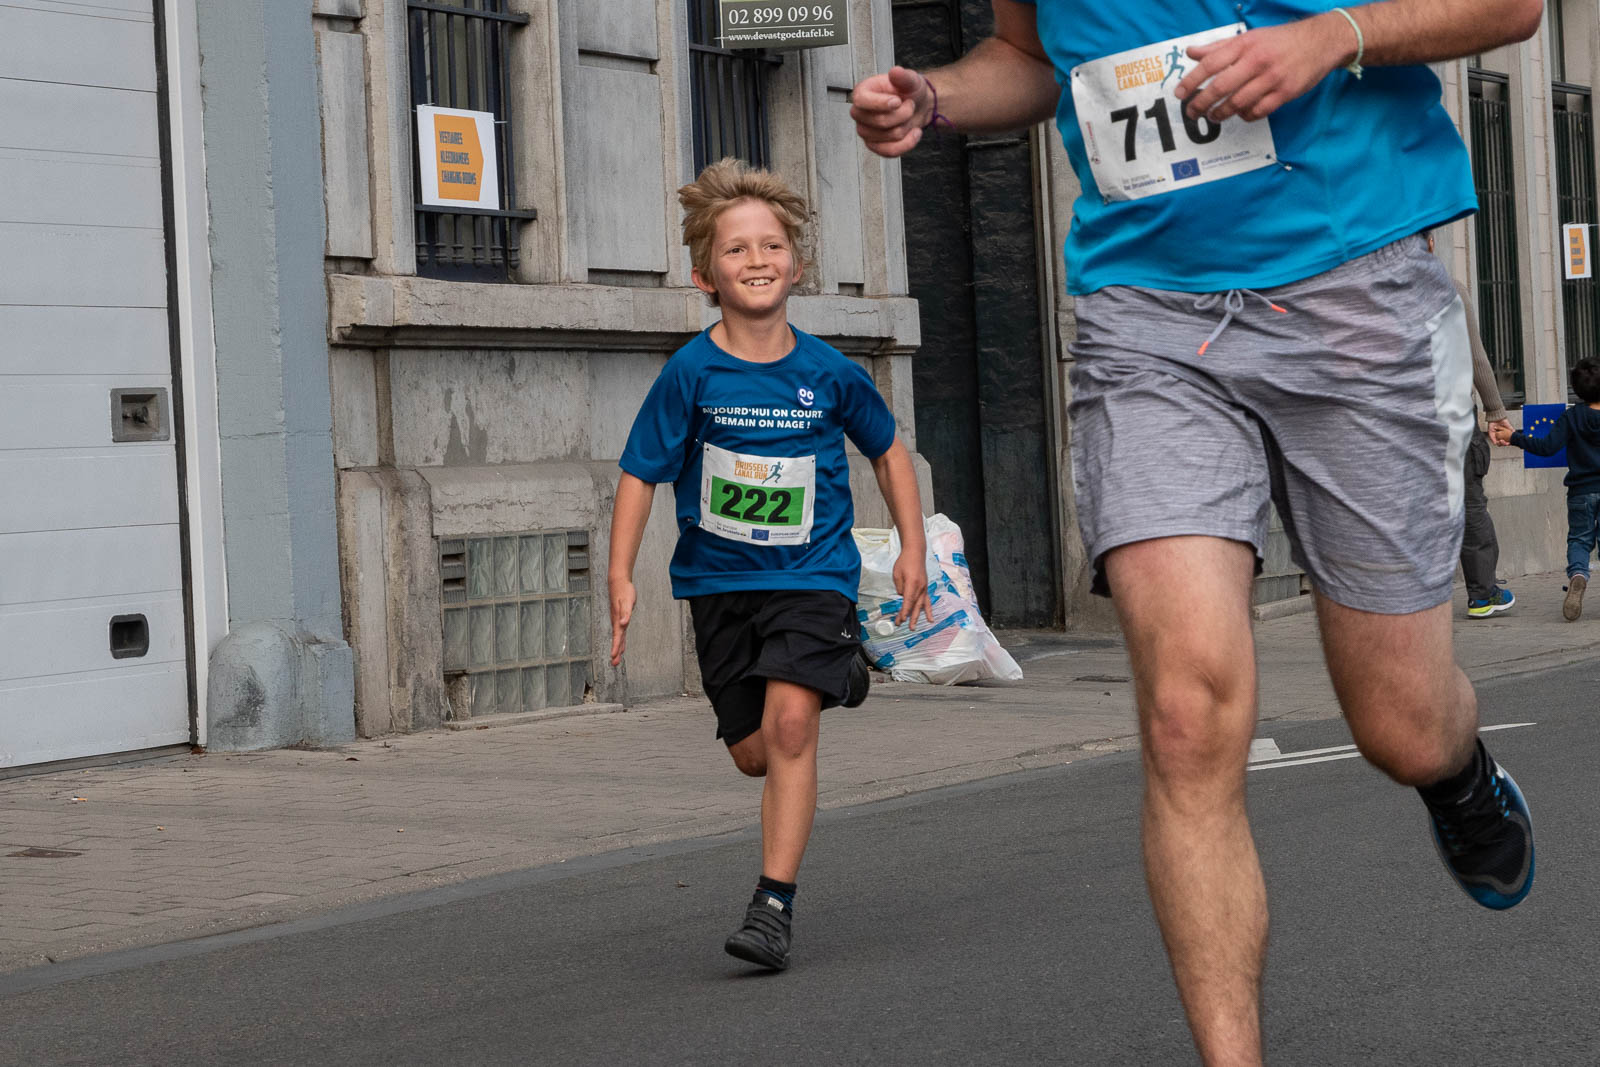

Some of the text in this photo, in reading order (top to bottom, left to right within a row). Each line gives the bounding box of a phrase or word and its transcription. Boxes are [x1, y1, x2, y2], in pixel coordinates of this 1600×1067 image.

[728, 5, 833, 24] 02 899 09 96
[728, 29, 835, 41] www.devastgoedtafel.be
[1115, 55, 1163, 79] BRUSSELS
[1117, 68, 1165, 91] CANAL RUN
[772, 409, 788, 418] ON
[714, 416, 756, 427] DEMAIN
[758, 419, 774, 428] ON
[776, 420, 805, 429] NAGE
[735, 460, 769, 472] BRUSSELS
[734, 469, 768, 480] CANAL RUN
[720, 484, 792, 524] 222
